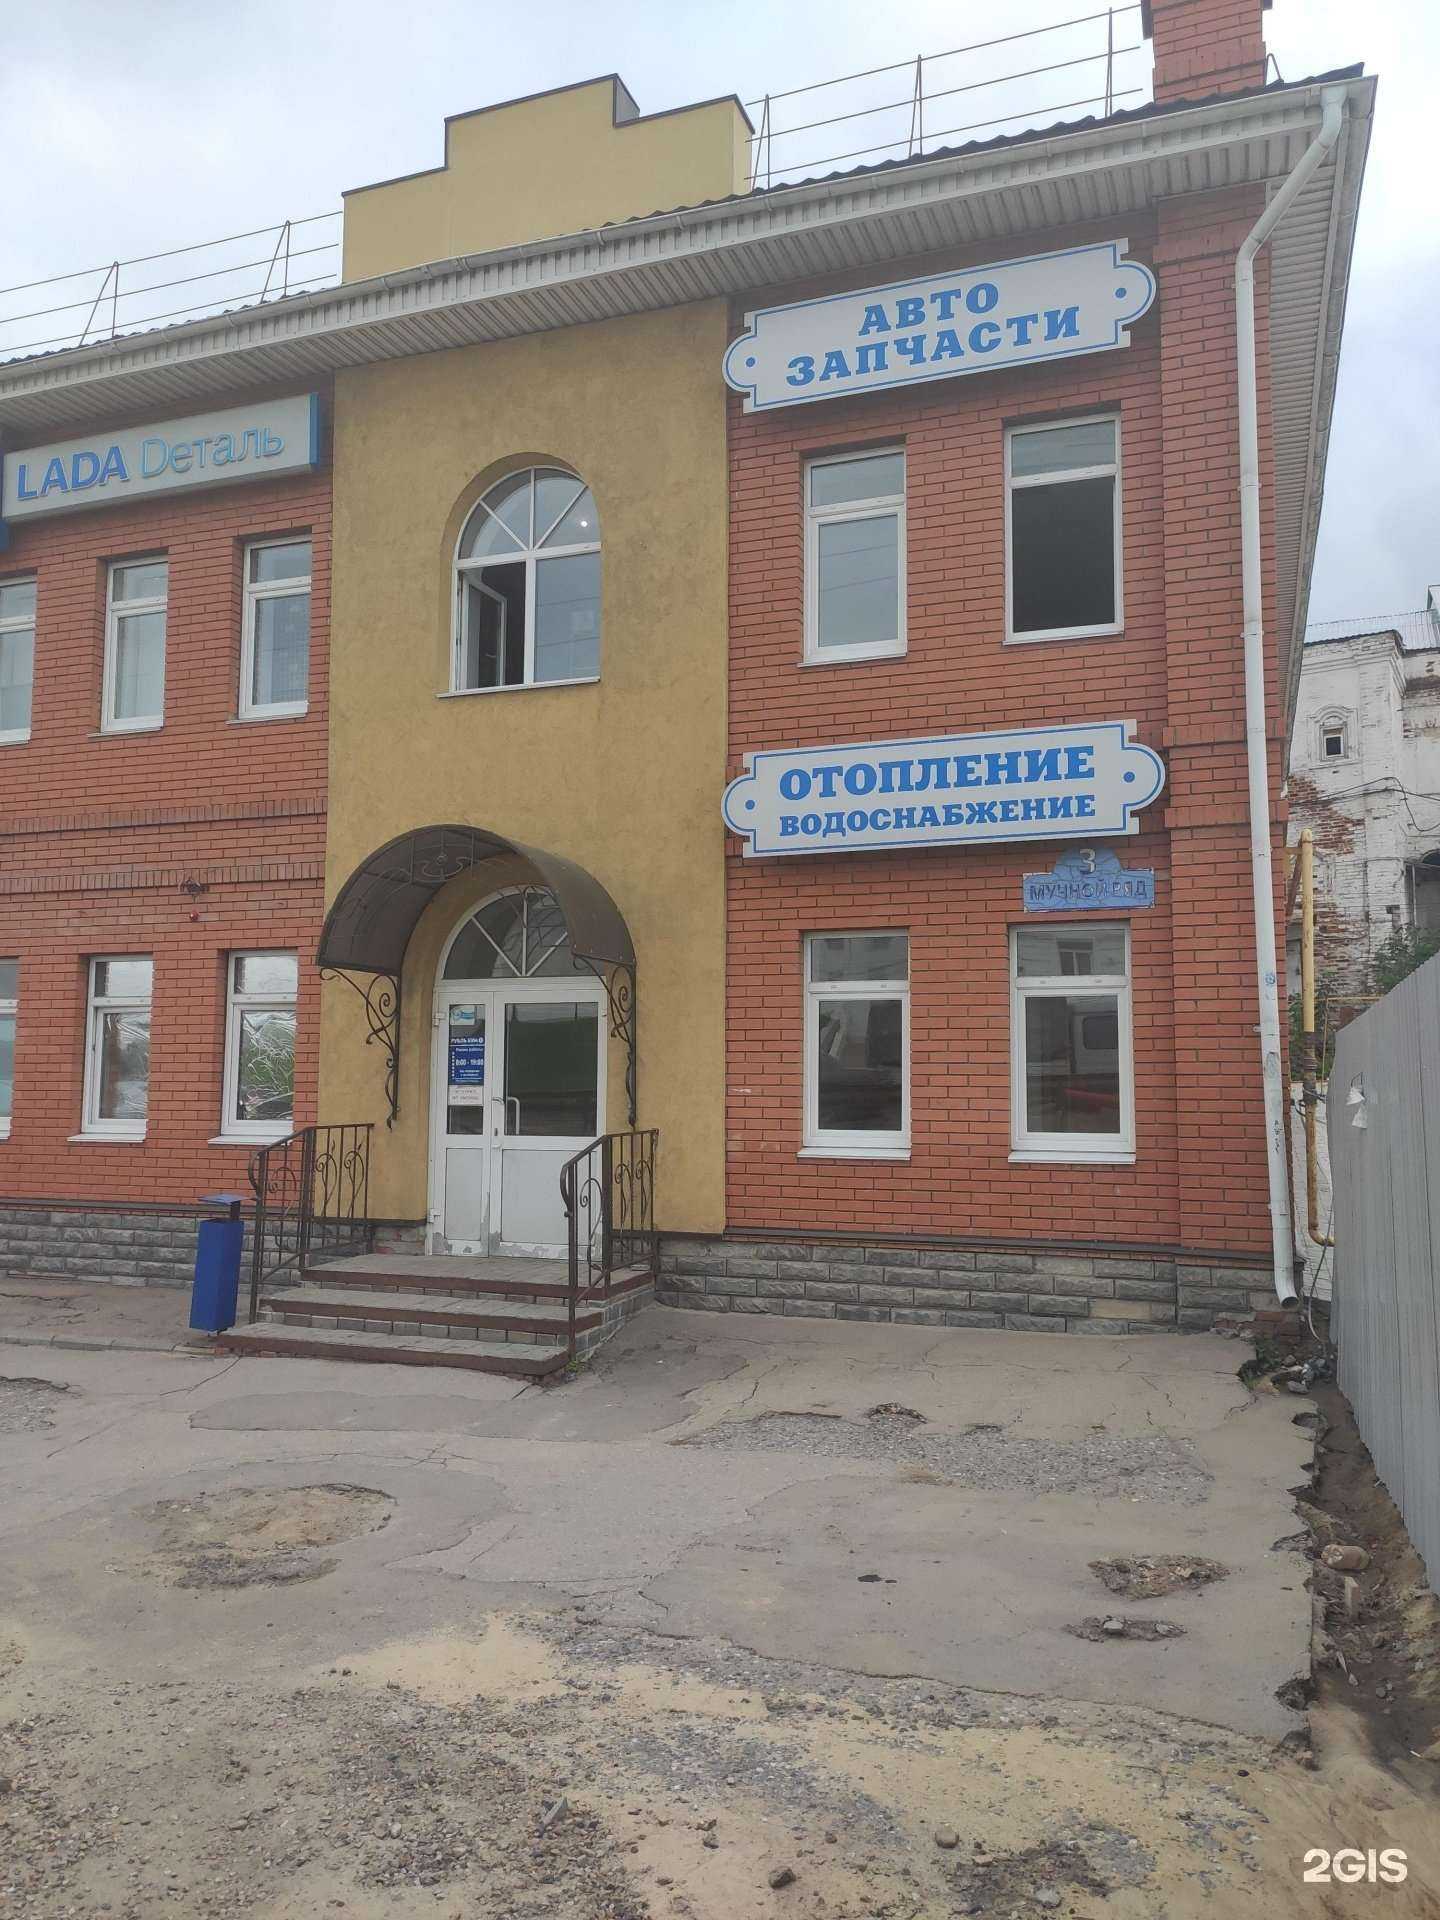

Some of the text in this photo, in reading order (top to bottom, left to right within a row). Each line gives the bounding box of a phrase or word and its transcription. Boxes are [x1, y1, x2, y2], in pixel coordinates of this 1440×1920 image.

[858, 282, 998, 336] АВТО
[786, 306, 1080, 386] ЗАПЧАСТИ
[17, 446, 129, 500] LADA
[779, 745, 1095, 800] ОТОПЛЕНИЕ
[779, 795, 1096, 837] ВОДОСНАБЖЕНИЕ
[1079, 848, 1097, 874] 3
